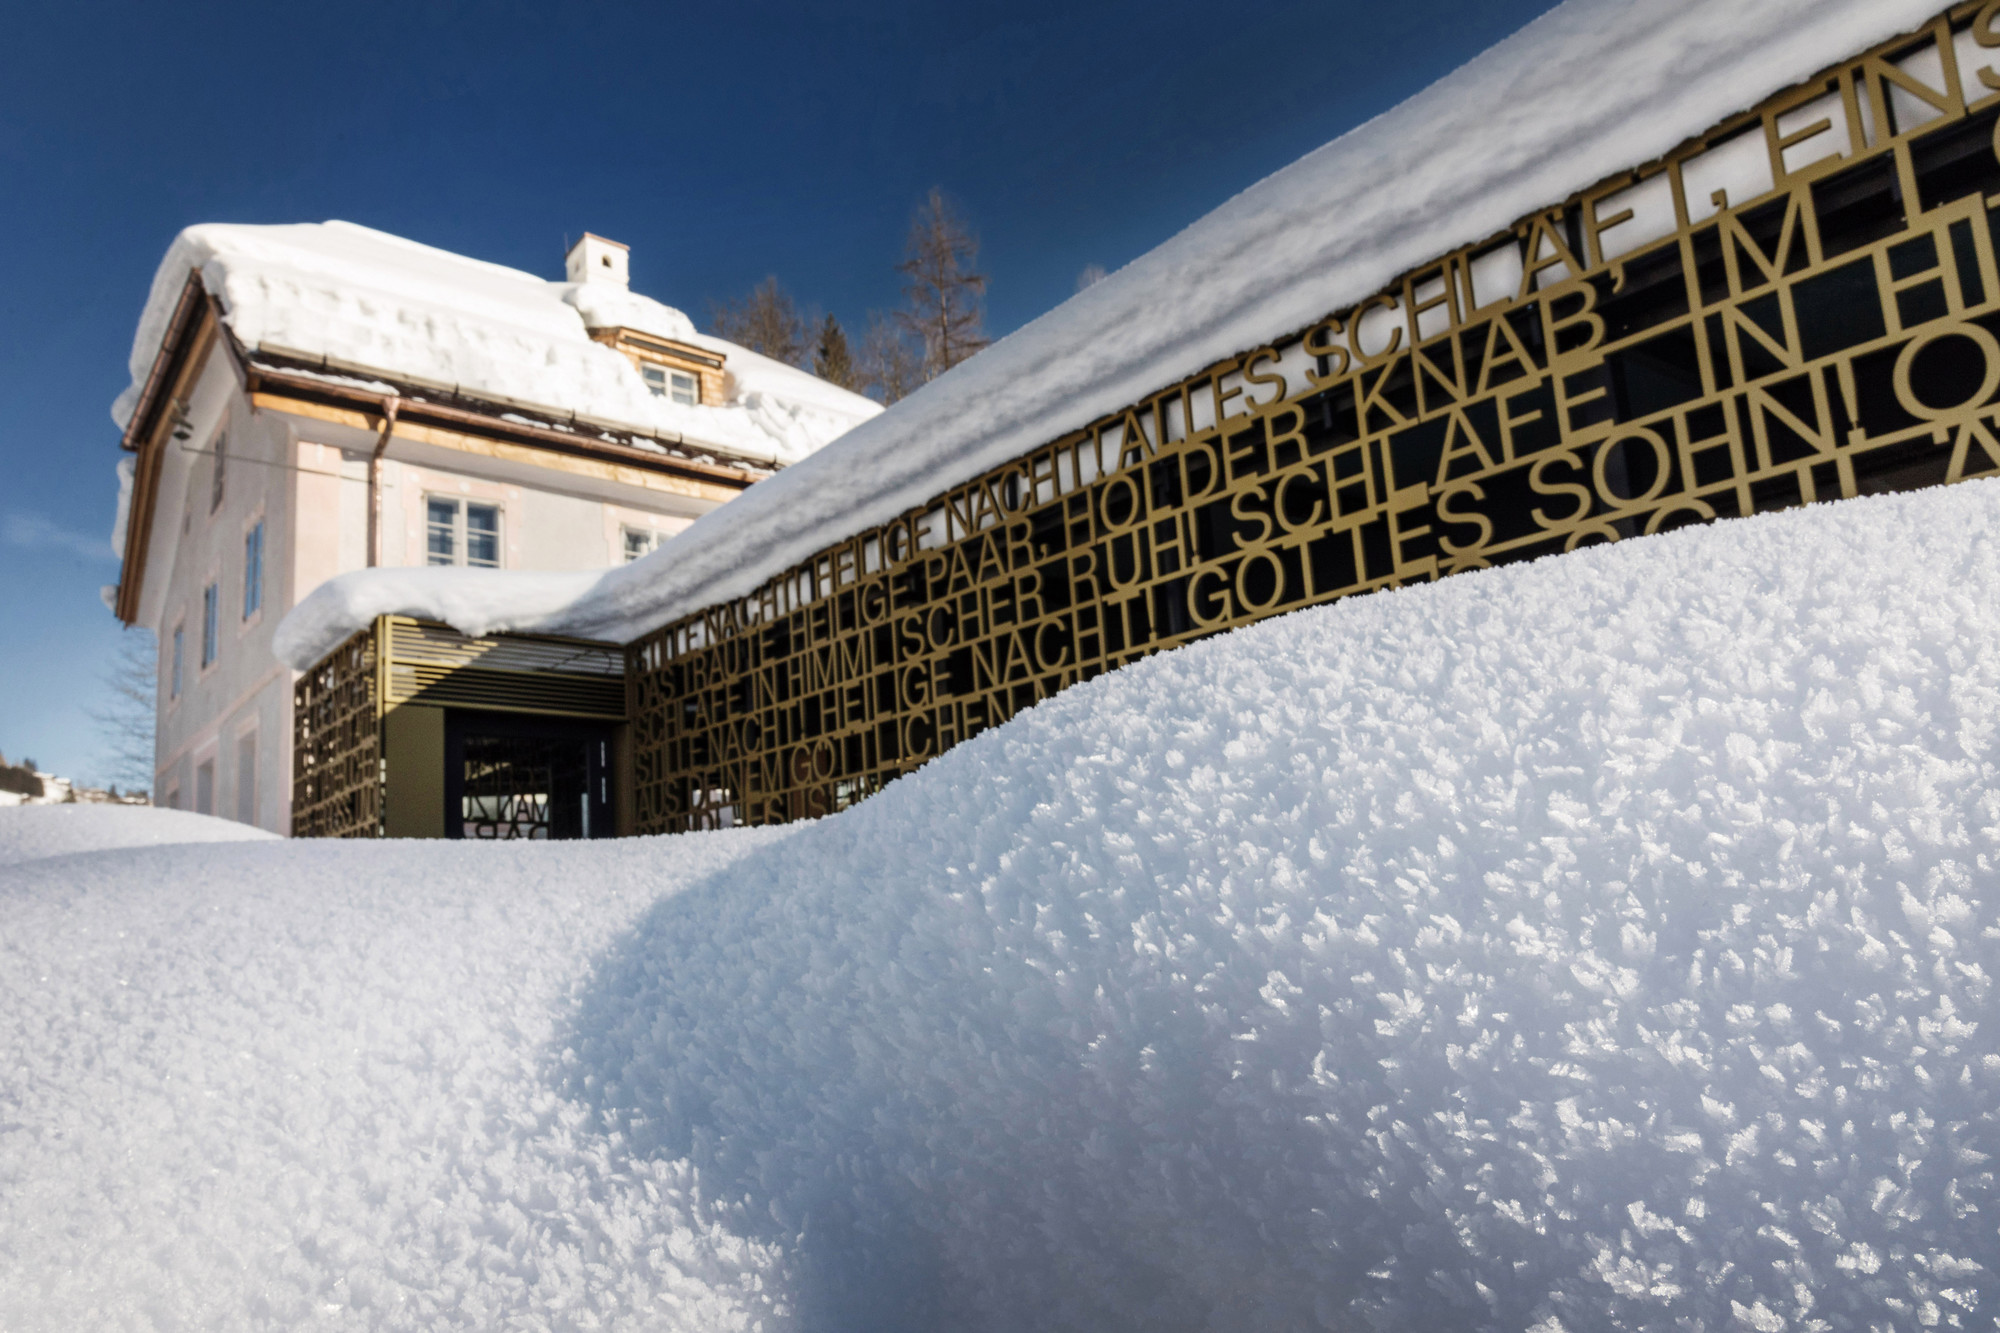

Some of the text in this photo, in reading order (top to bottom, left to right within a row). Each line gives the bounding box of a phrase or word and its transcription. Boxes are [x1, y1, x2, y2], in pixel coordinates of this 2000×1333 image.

[632, 612, 703, 673] STILLE
[702, 566, 802, 648] NACHT!
[812, 507, 933, 603] HEILIGE
[944, 427, 1104, 543] NACHT!
[1117, 346, 1287, 472] ALLES
[1303, 142, 1728, 386] SCHLÄFT,
[634, 665, 676, 711] DAS
[679, 623, 776, 694] TRAUTE
[788, 565, 911, 655] HEILIGE
[924, 517, 1050, 603] PAAR,
[1062, 403, 1311, 551] HOLDER
[1678, 182, 1823, 314] IM
[634, 732, 704, 783] STILLE
[708, 698, 806, 766] NACHT!
[819, 652, 953, 735] HEILIGE
[971, 585, 1158, 692] NACHT!
[1187, 481, 1494, 627] GOTTES
[1528, 356, 1867, 531] SOHN!
[635, 677, 742, 747] SCHLAFE
[750, 661, 778, 712] IN
[787, 568, 1047, 704] HIMMLISCHER
[1067, 507, 1202, 607] RUH!
[1230, 353, 1615, 551] SCHLAFE
[1692, 280, 1804, 398] IN
[637, 686, 1014, 820] AUS DEINEM GÖTTLICHEN
